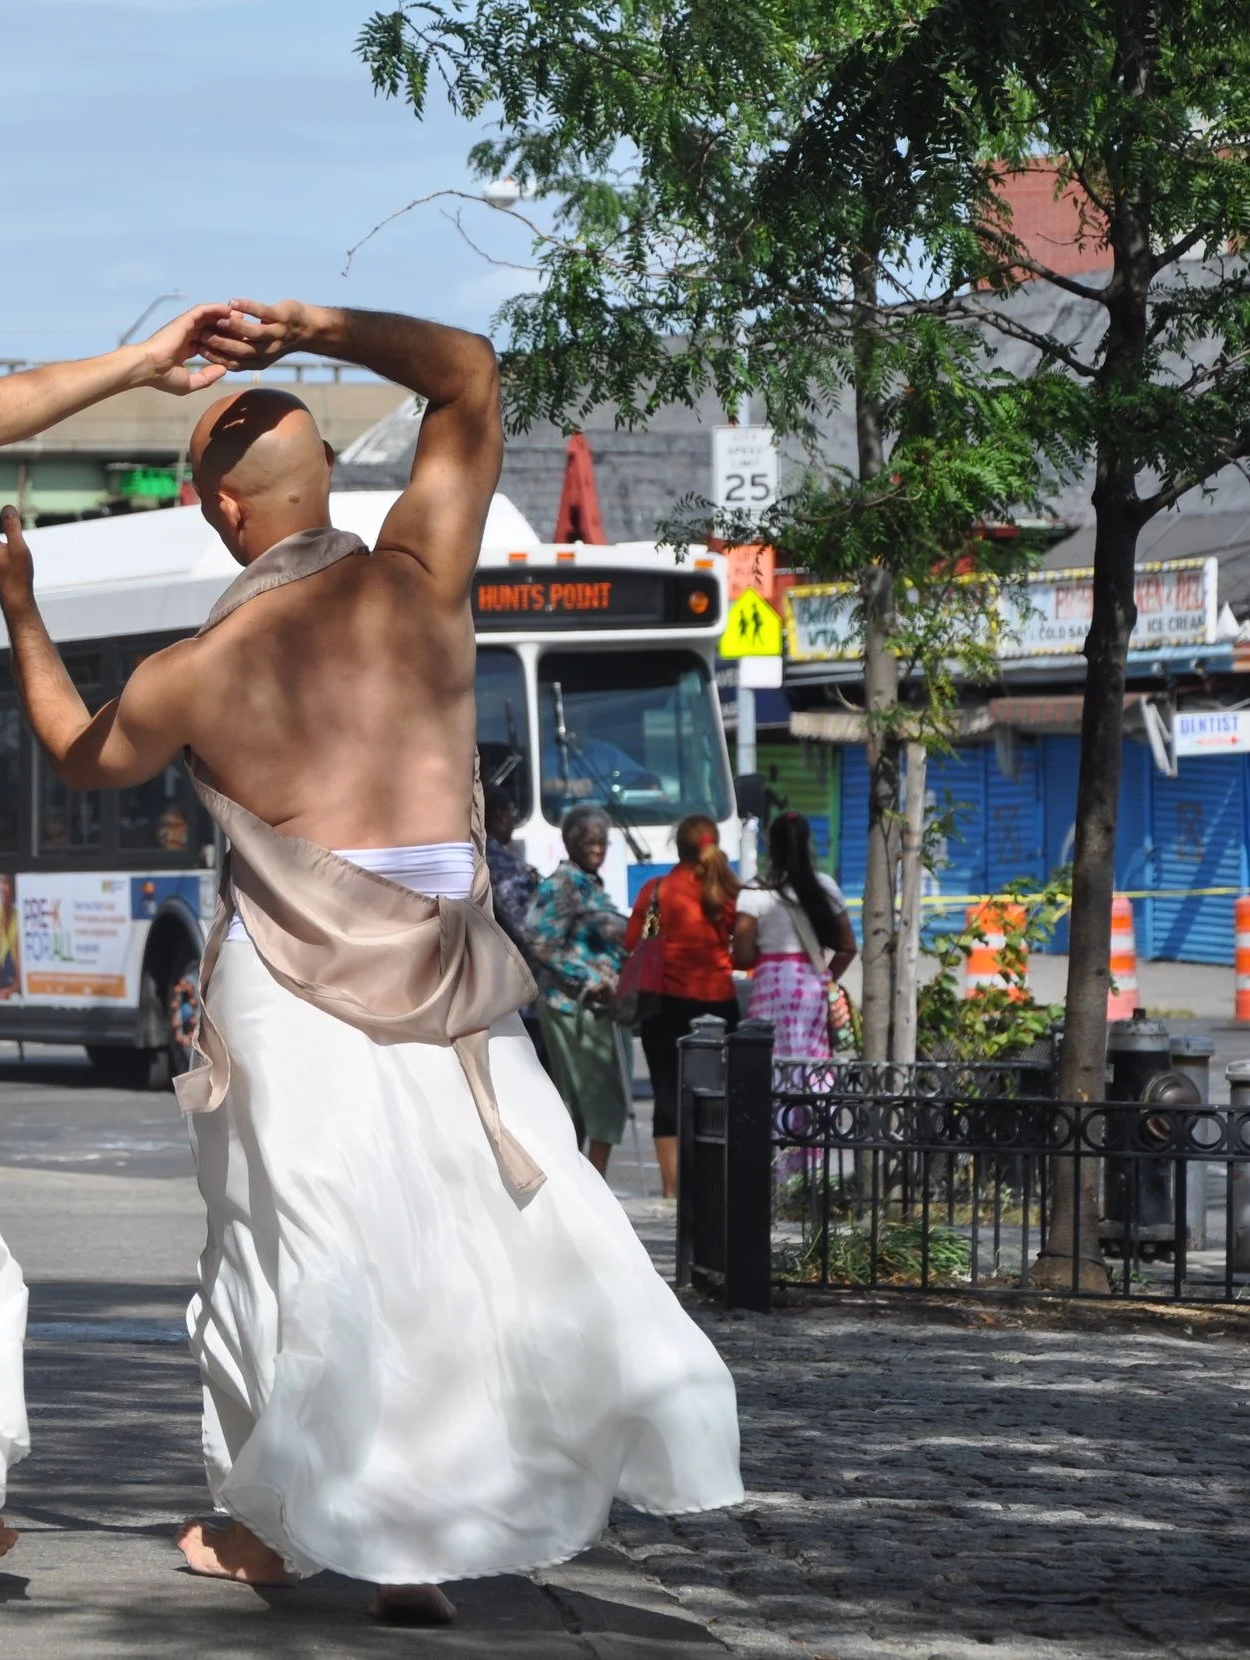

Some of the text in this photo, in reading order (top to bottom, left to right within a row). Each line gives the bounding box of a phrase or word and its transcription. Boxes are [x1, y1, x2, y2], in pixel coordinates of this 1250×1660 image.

[725, 473, 770, 502] 25
[477, 582, 611, 611] HUNTS POINT
[1180, 715, 1238, 734] DENTIST
[23, 897, 64, 930] PRE-K
